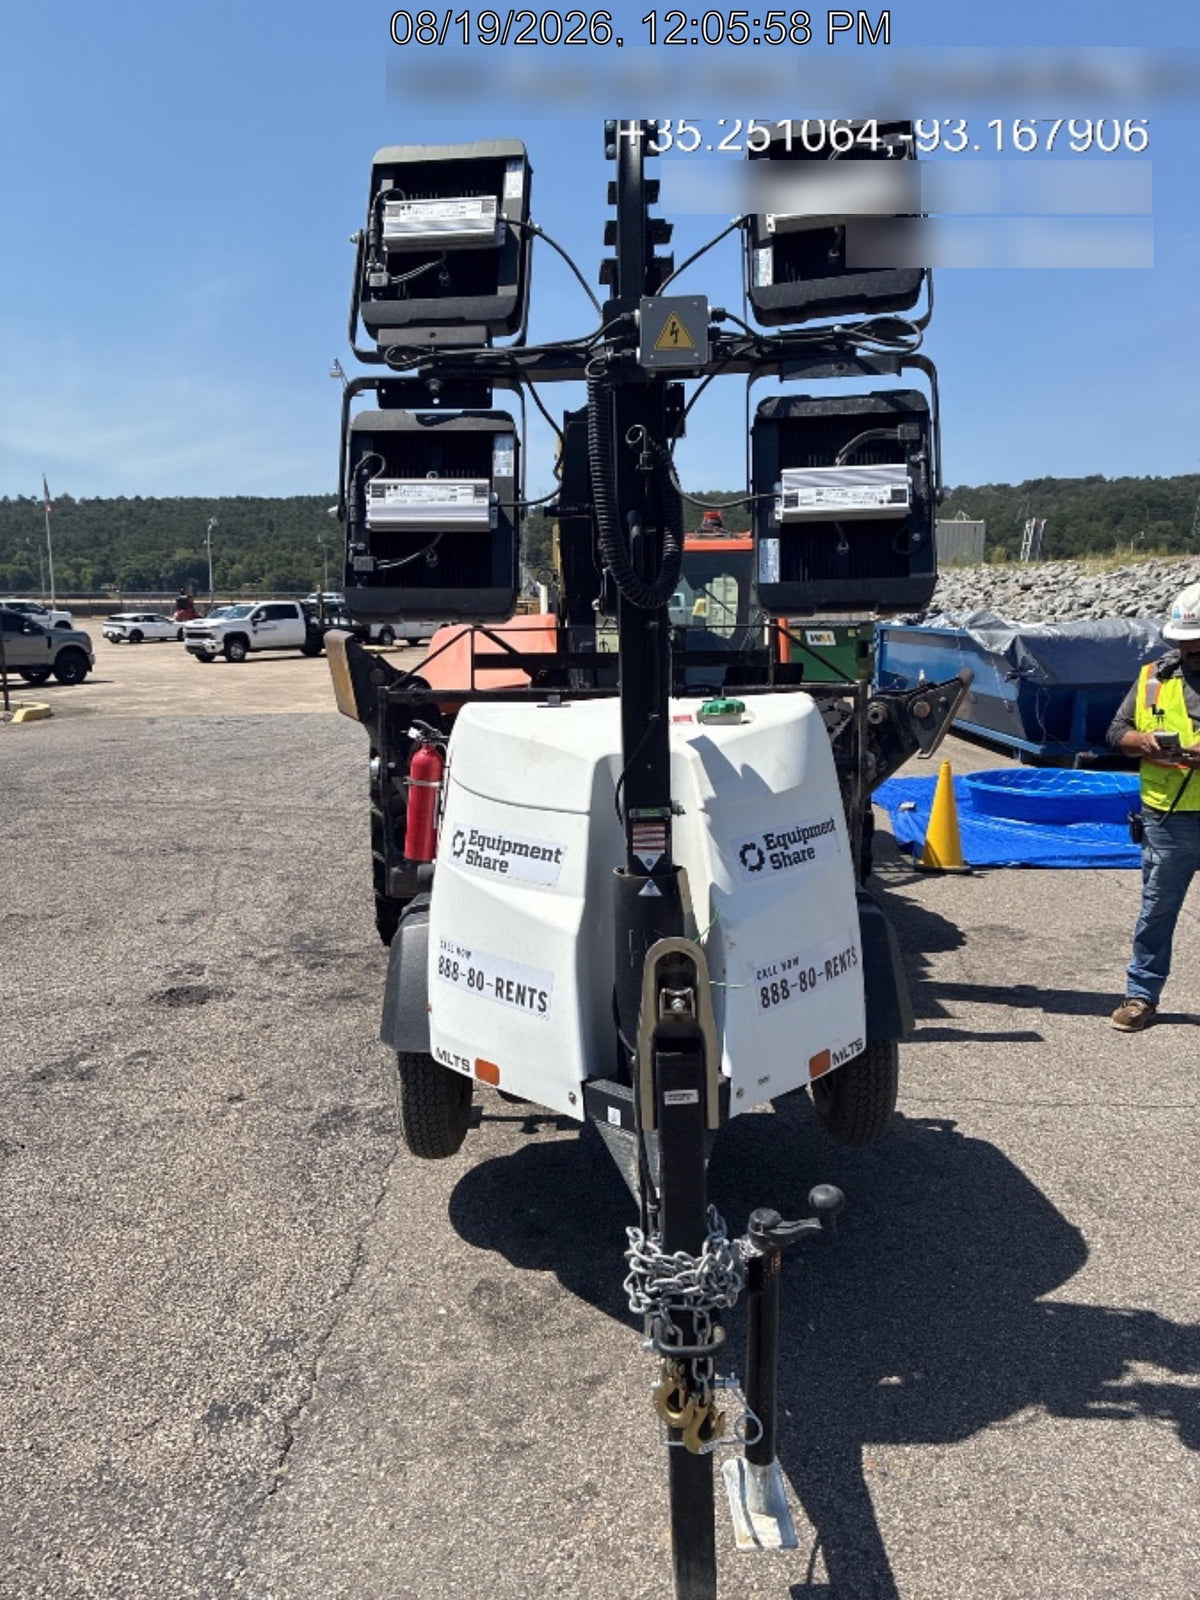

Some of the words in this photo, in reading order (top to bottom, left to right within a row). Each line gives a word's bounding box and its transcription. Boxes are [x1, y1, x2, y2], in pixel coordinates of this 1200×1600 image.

[468, 829, 562, 864] Equipment
[763, 817, 836, 850] Equipment
[465, 849, 509, 873] Share
[769, 847, 815, 870] Share
[438, 955, 548, 1012] 888-80-RENTS
[757, 965, 778, 981] CALL
[760, 945, 858, 1008] 888-80-RENTS
[436, 1046, 470, 1072] MLTS
